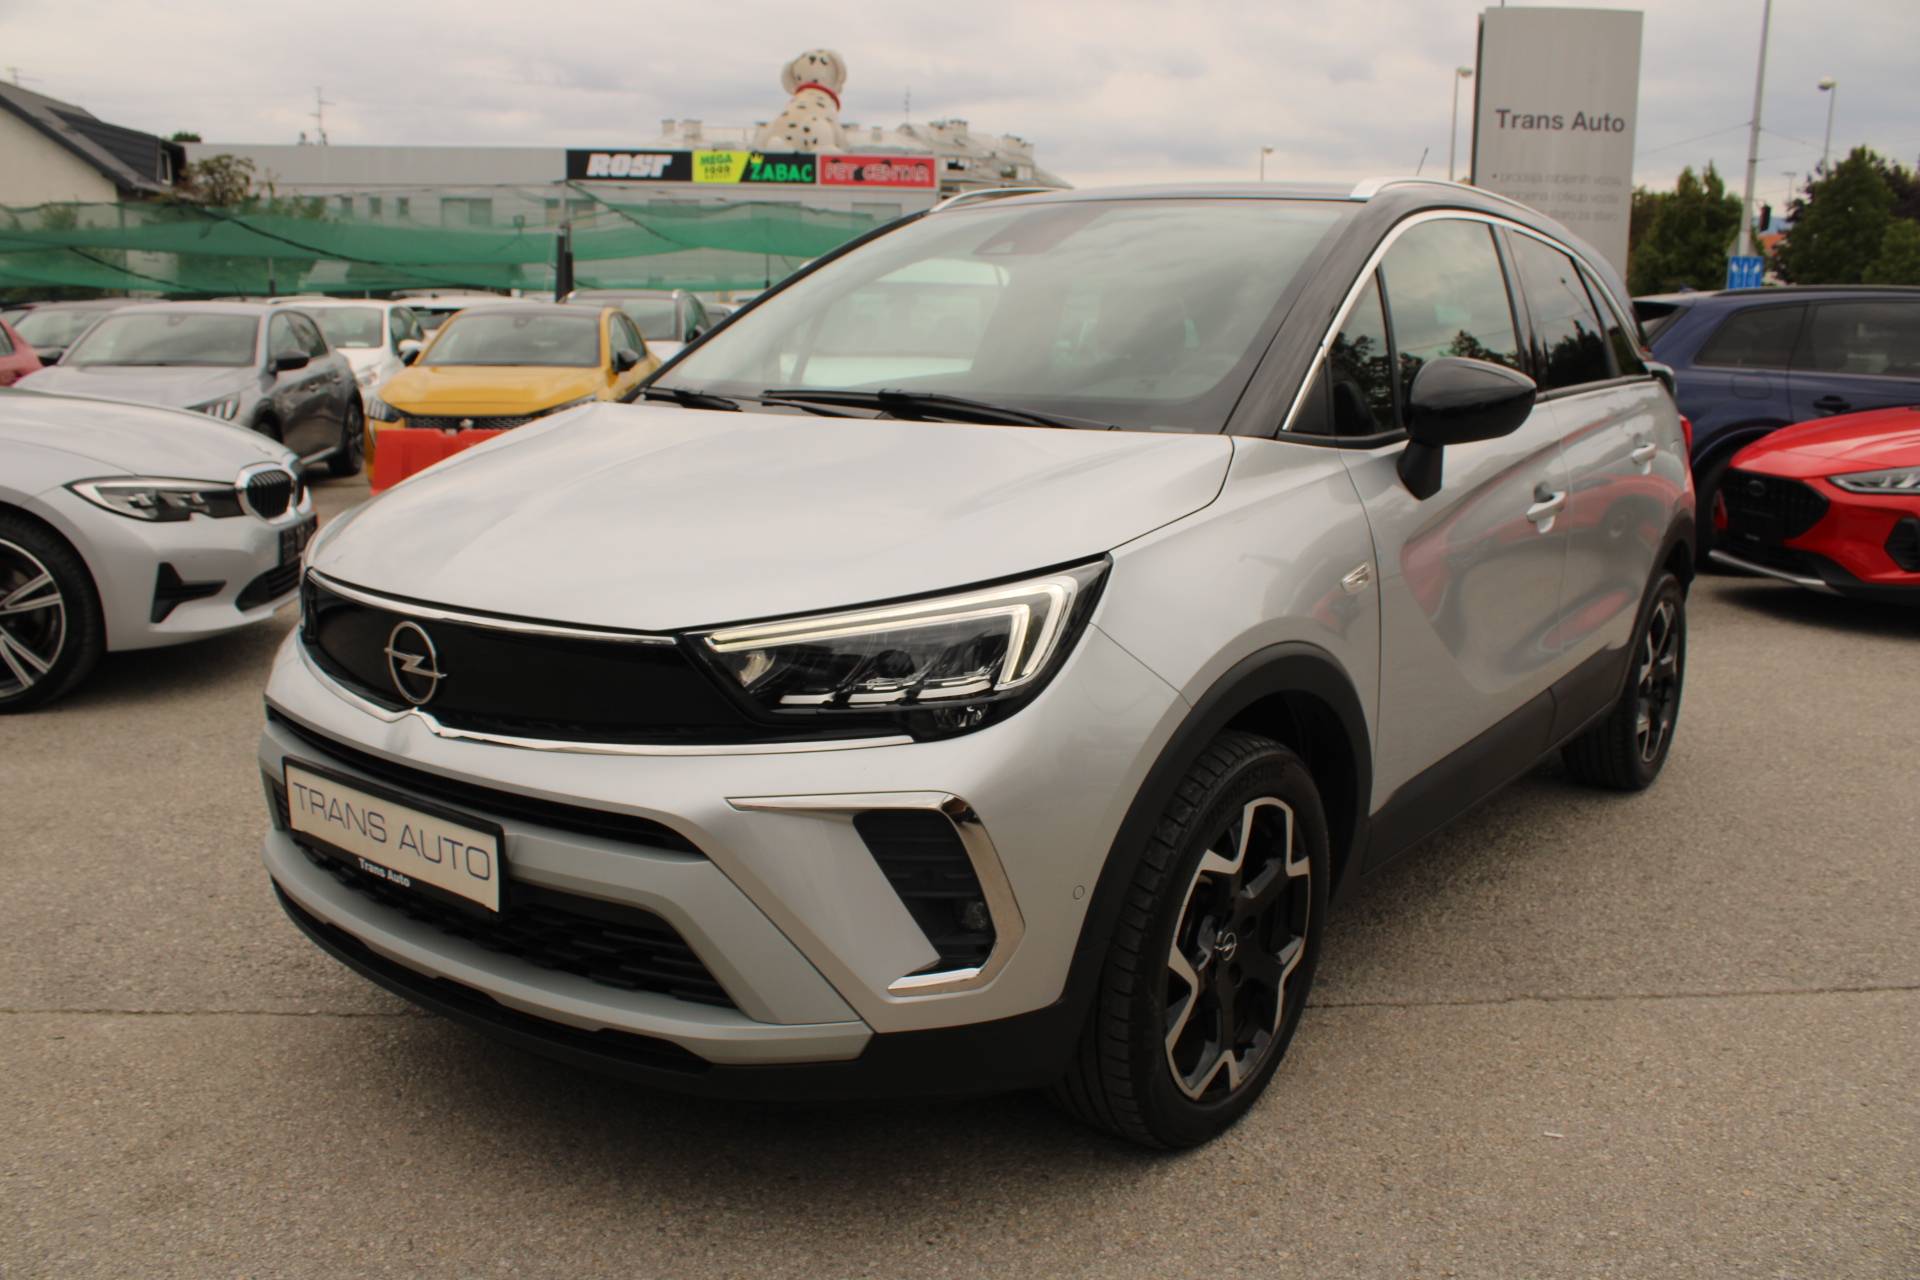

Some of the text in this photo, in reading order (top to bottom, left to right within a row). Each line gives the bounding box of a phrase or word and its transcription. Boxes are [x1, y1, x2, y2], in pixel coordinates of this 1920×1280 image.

[1495, 109, 1625, 133] Trans Auto
[586, 153, 672, 177] ROST
[701, 153, 732, 165] MEGA
[293, 782, 490, 881] TRANS AUTO
[358, 857, 410, 887] Trans Auto
